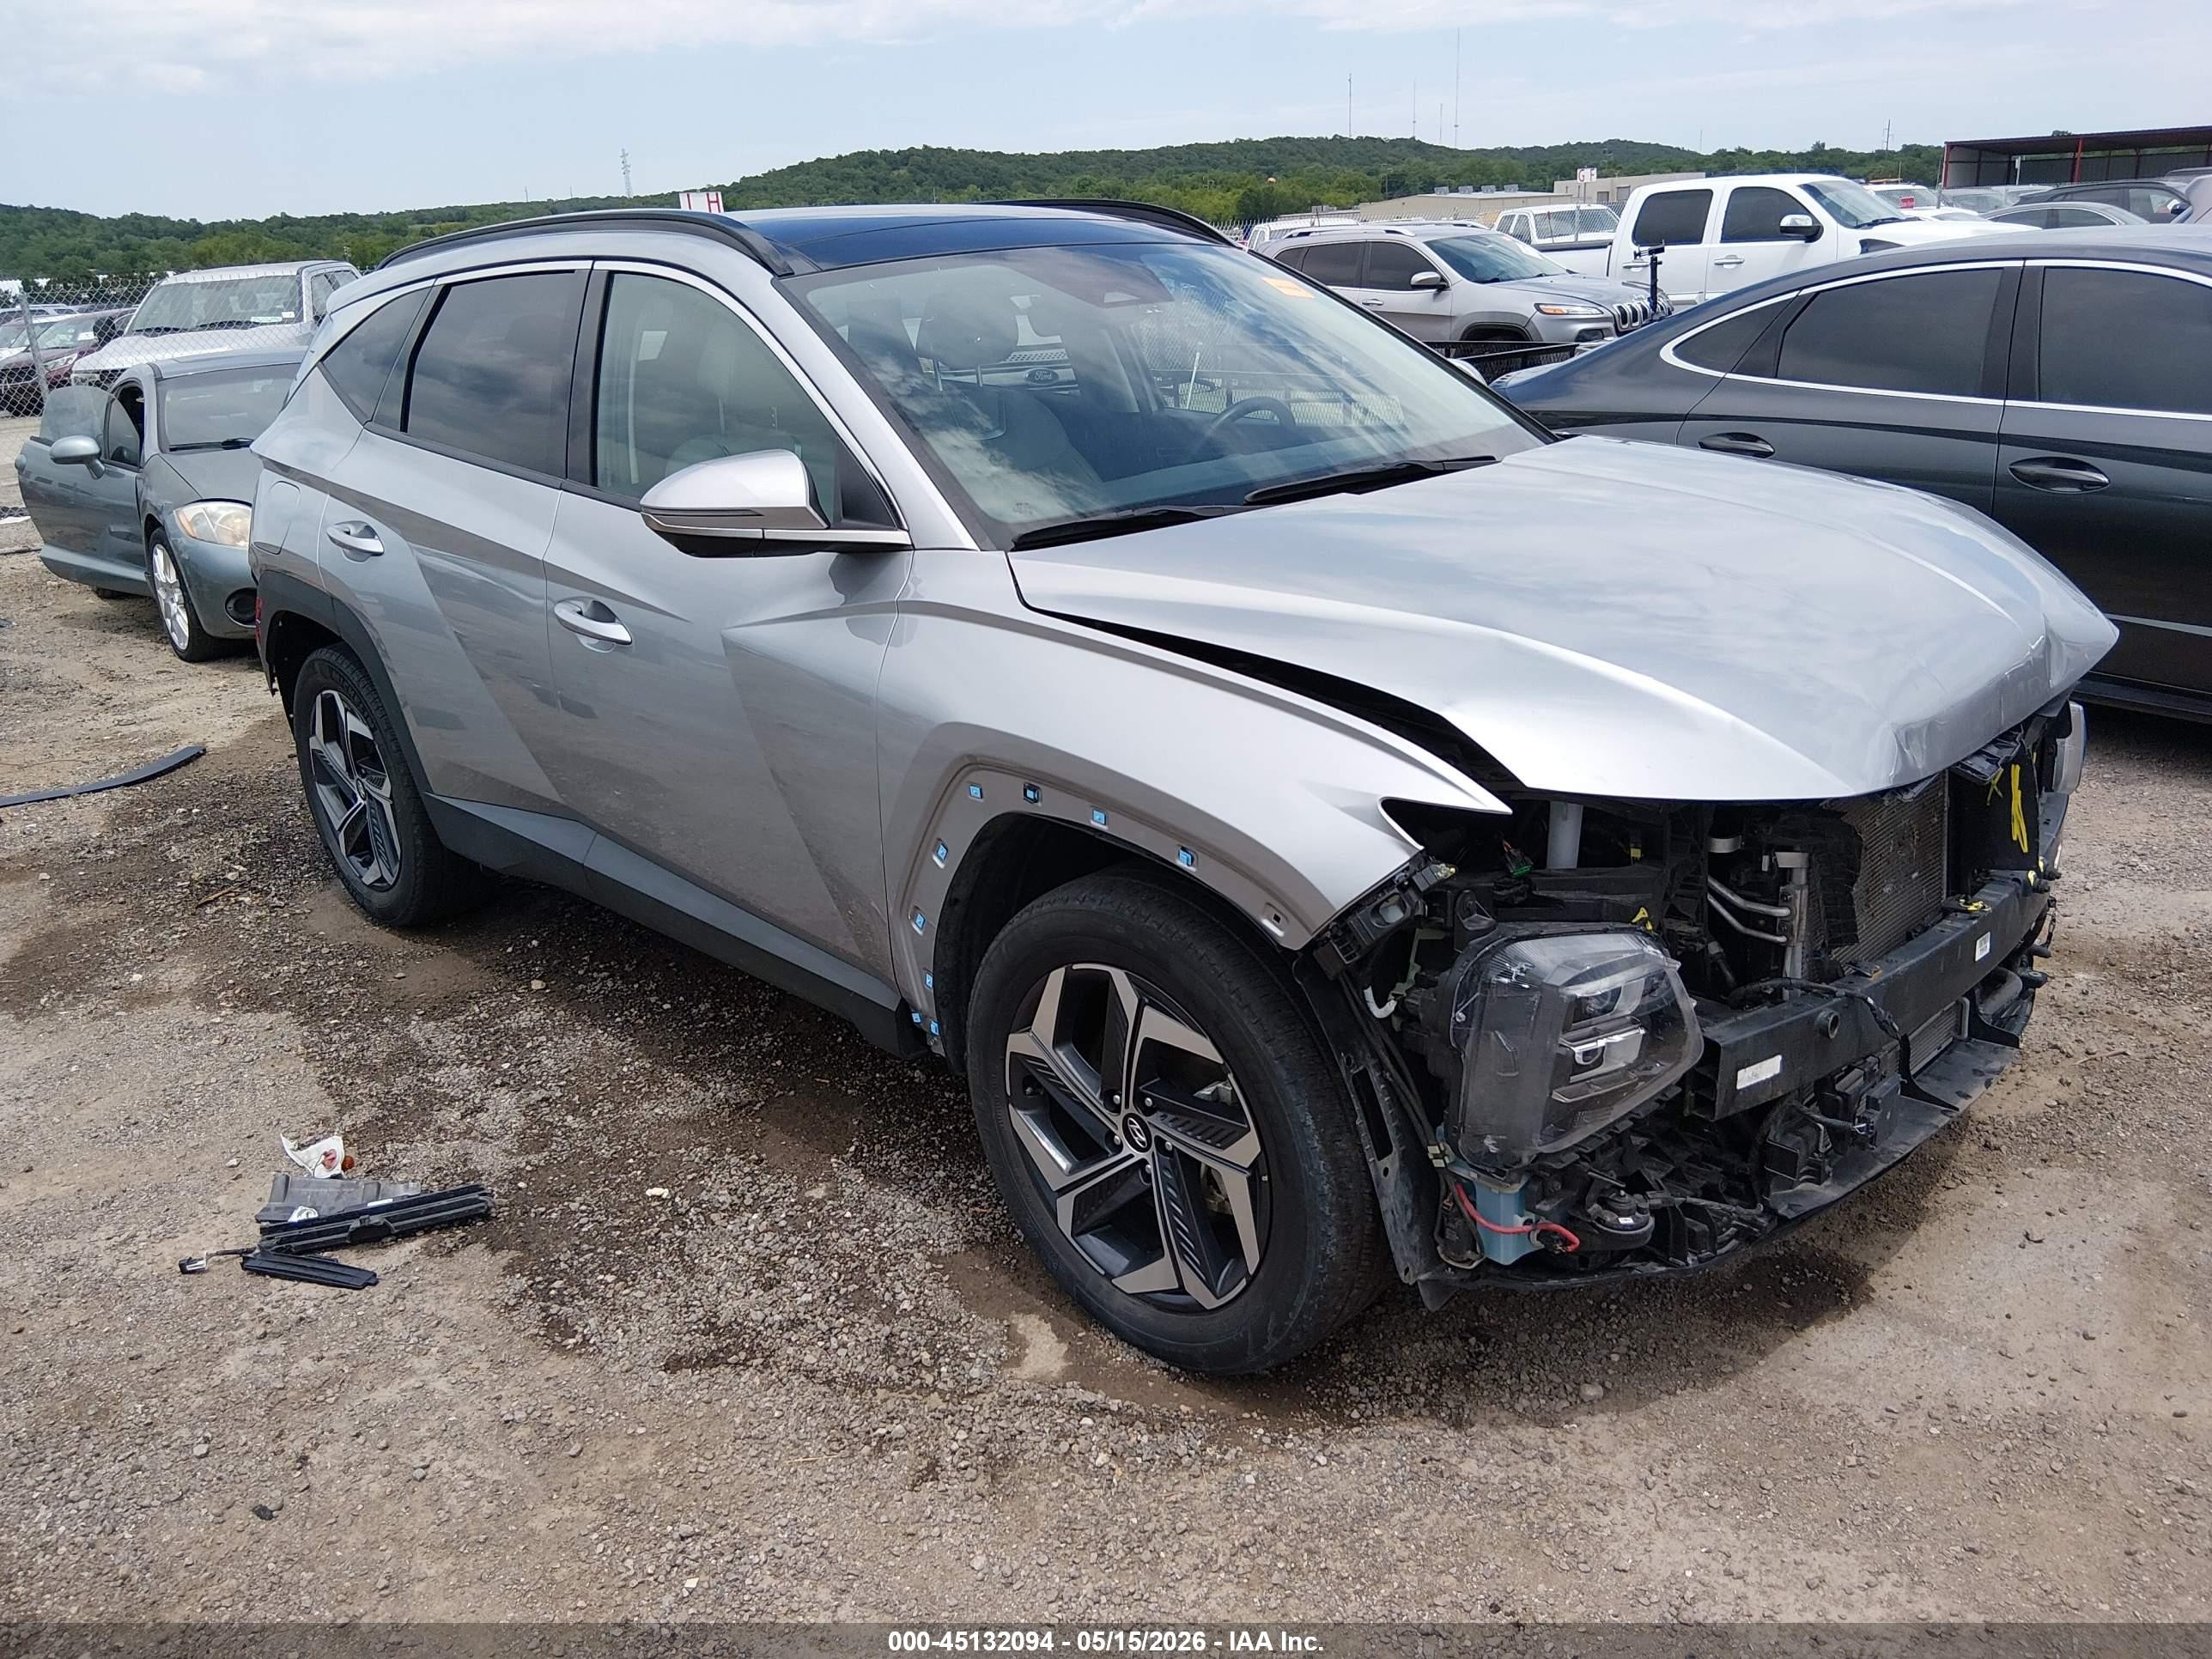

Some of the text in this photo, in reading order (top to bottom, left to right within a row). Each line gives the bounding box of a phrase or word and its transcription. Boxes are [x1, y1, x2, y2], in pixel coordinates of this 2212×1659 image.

[1579, 168, 1585, 182] G
[707, 192, 721, 213] H
[1034, 370, 1052, 380] Ford
